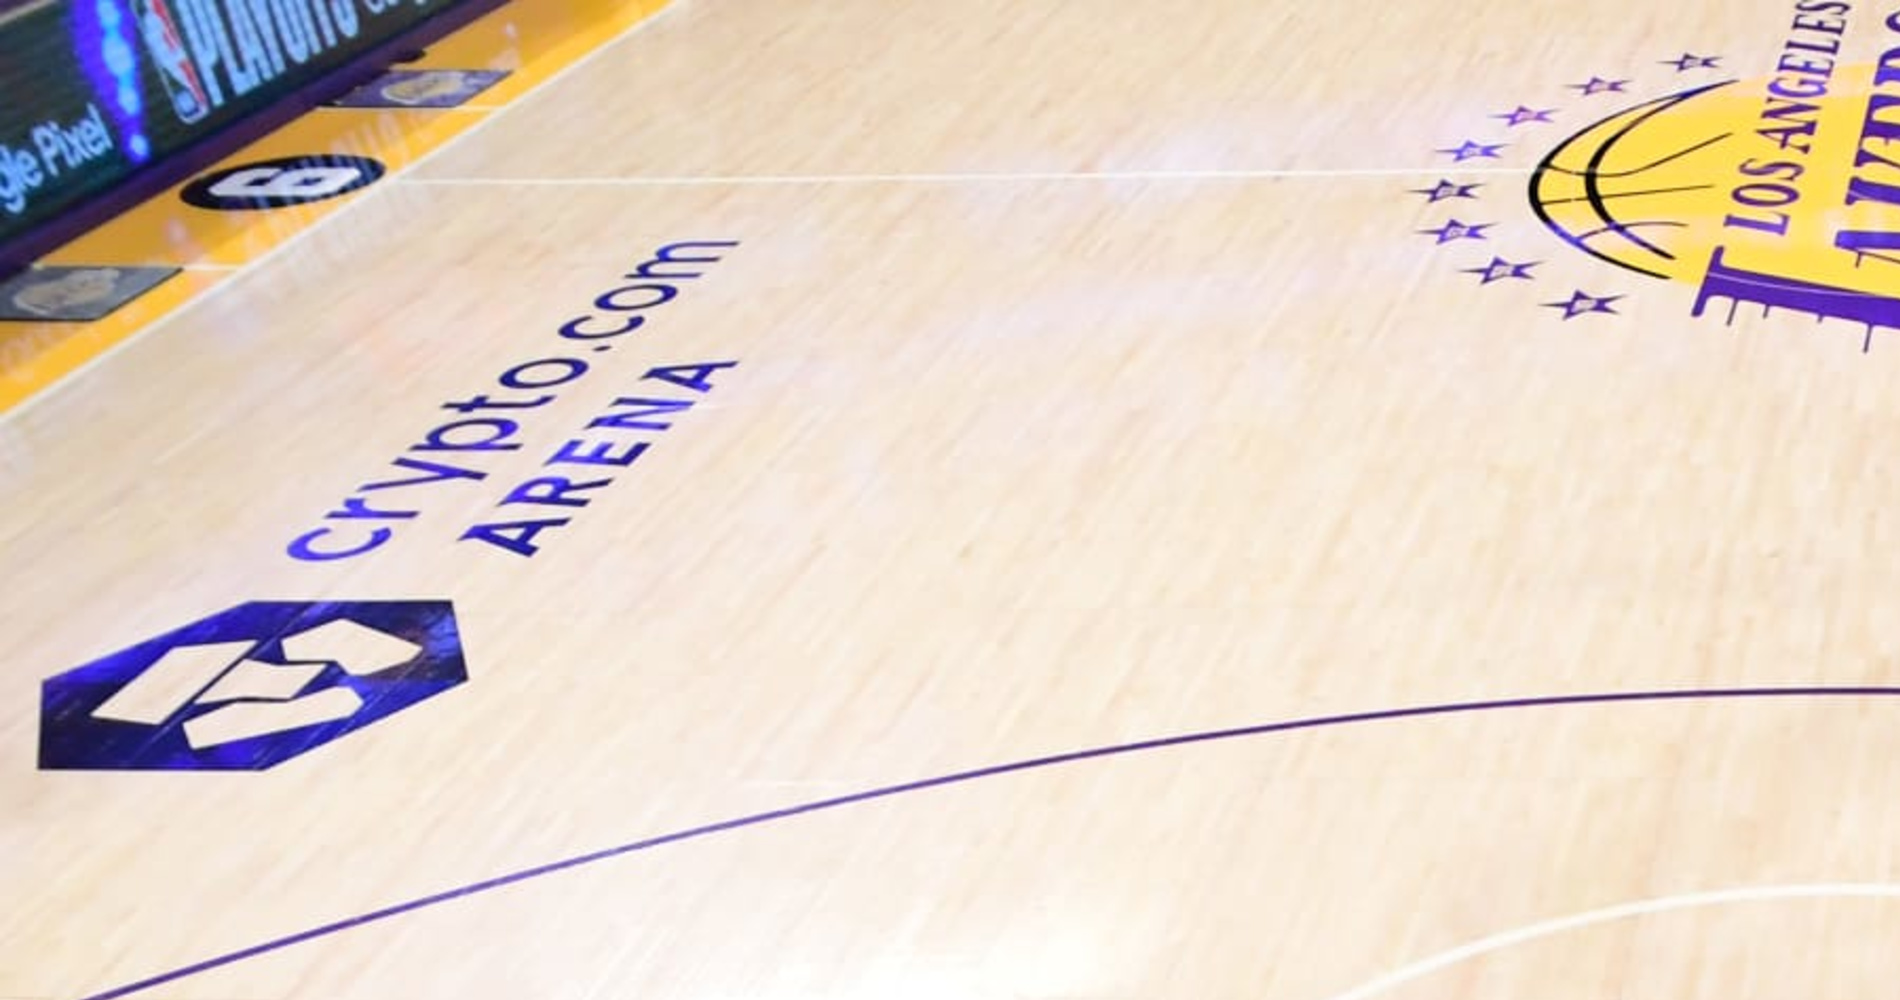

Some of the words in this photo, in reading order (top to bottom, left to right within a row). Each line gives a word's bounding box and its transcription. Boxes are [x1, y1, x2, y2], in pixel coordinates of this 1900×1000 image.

[32, 102, 114, 177] Pixel
[1755, 1, 1850, 154] ANGELES
[1723, 158, 1804, 236] LOS
[286, 240, 741, 562] crypto.com
[457, 361, 740, 558] ARENA
